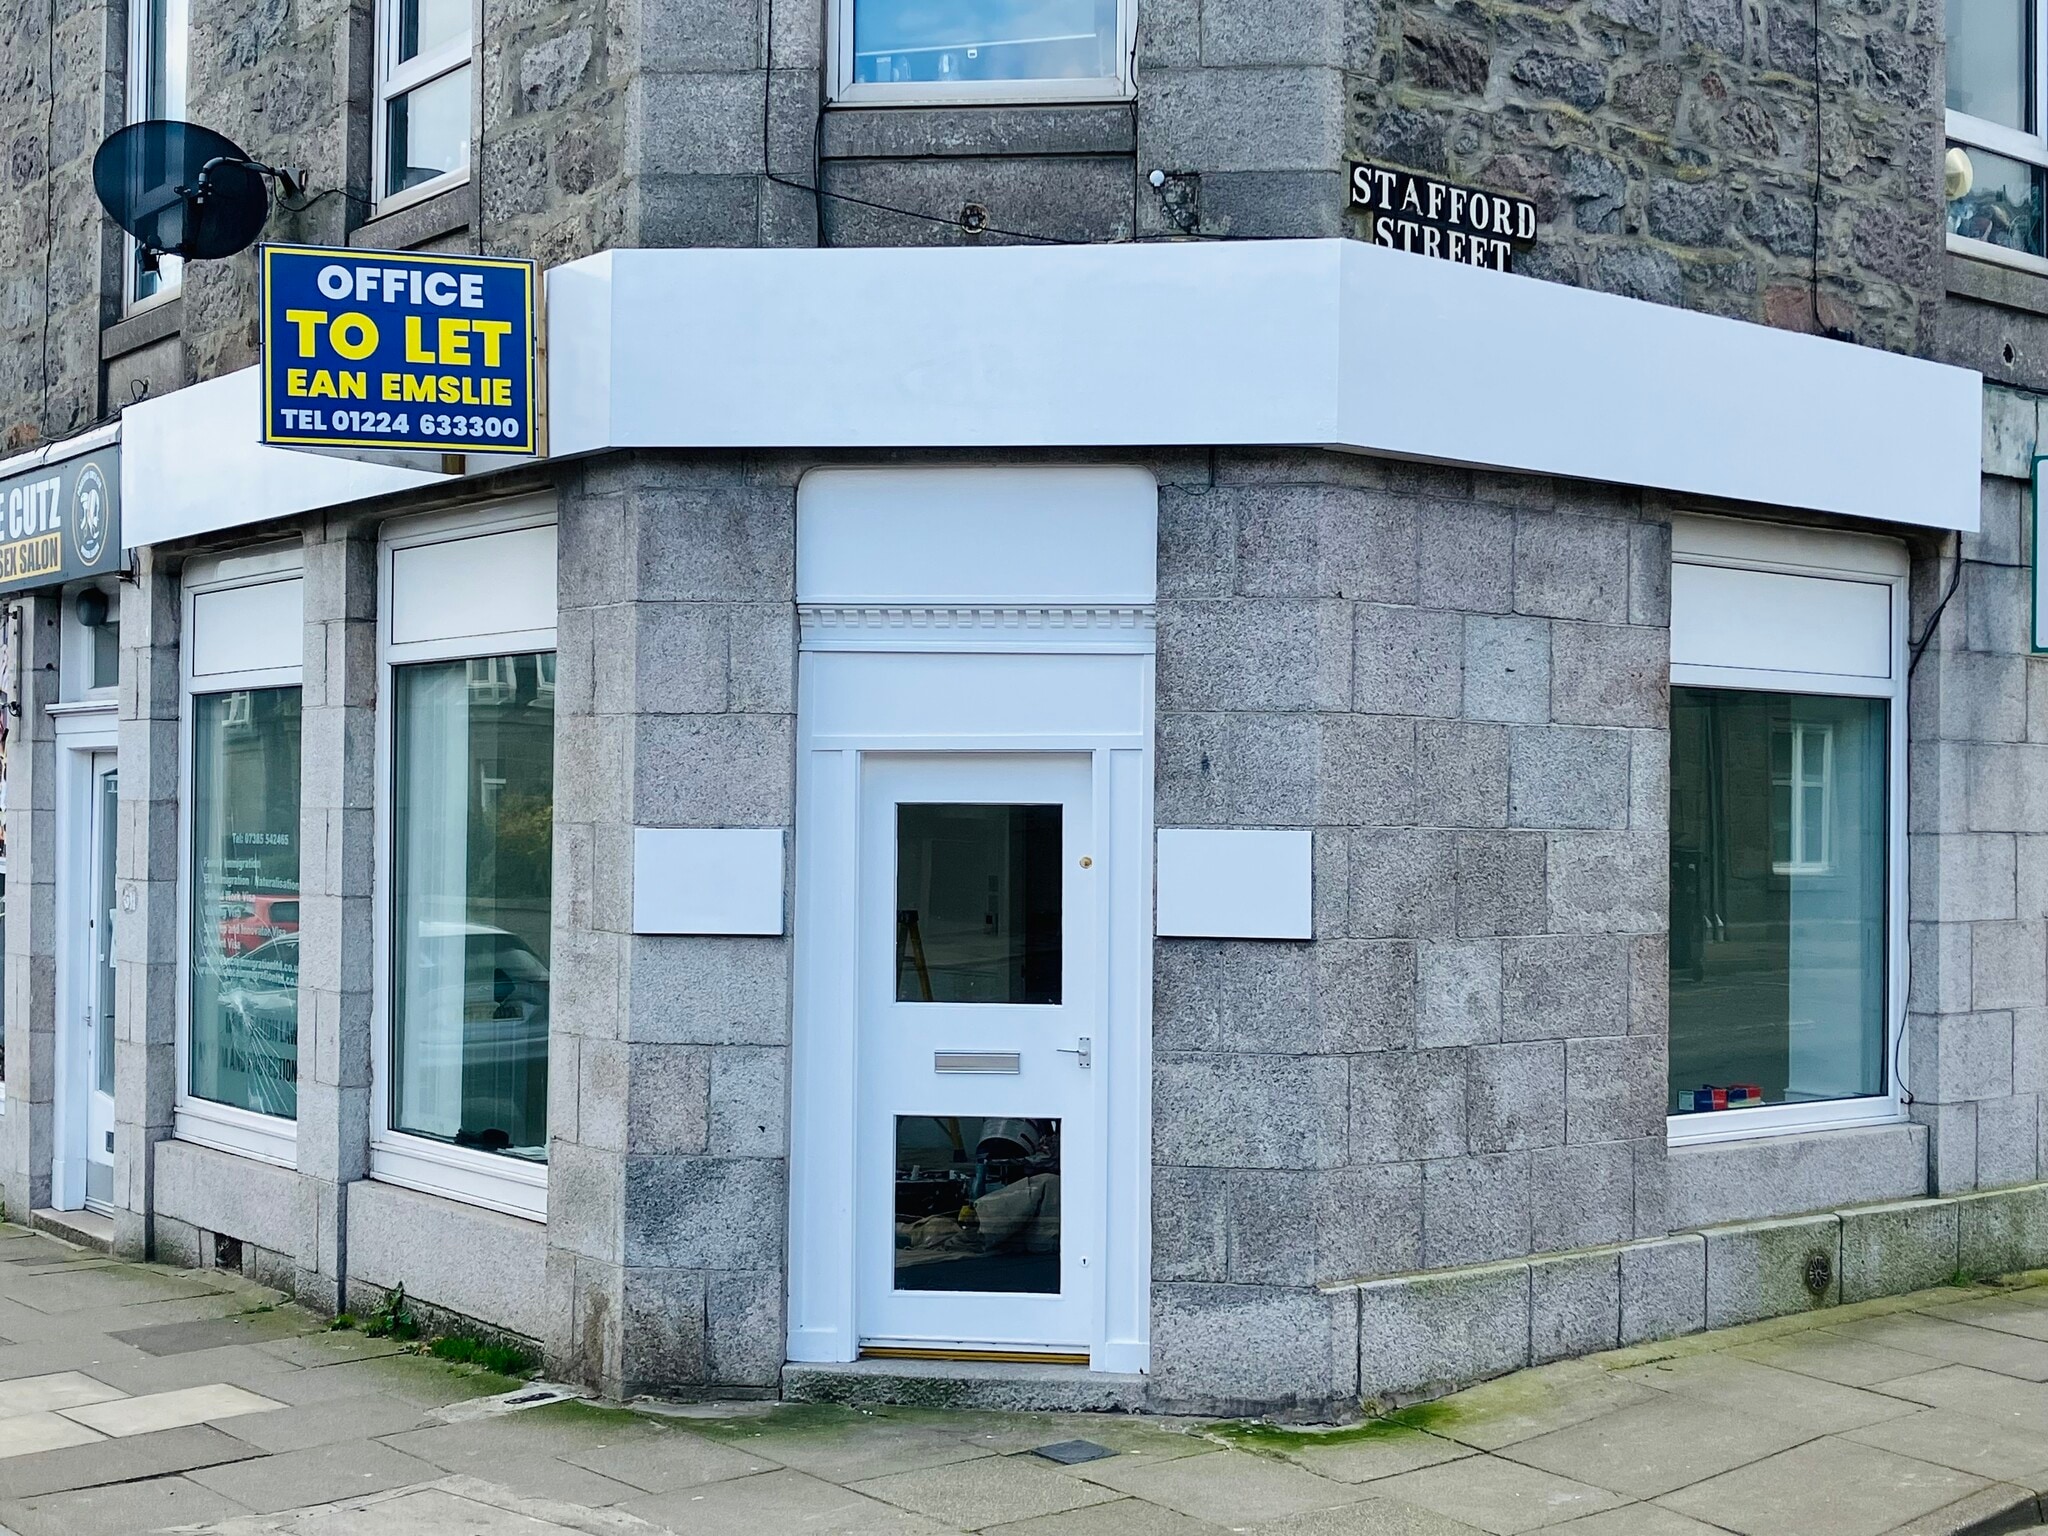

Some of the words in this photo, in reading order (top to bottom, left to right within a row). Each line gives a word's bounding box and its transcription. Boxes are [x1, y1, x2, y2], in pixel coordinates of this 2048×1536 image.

[1353, 166, 1536, 239] STAFFORD
[1375, 217, 1511, 272] STREET
[317, 264, 484, 309] OFFICE
[286, 309, 379, 360] TO
[405, 315, 512, 367] LET
[287, 368, 366, 400] EAN
[382, 372, 512, 407] EMSLIE
[280, 408, 327, 430] TEL
[332, 409, 409, 434] 01224
[419, 413, 519, 438] 633300
[9, 476, 61, 539] CUTZ
[19, 536, 58, 574] SALON
[265, 834, 289, 845] 542465
